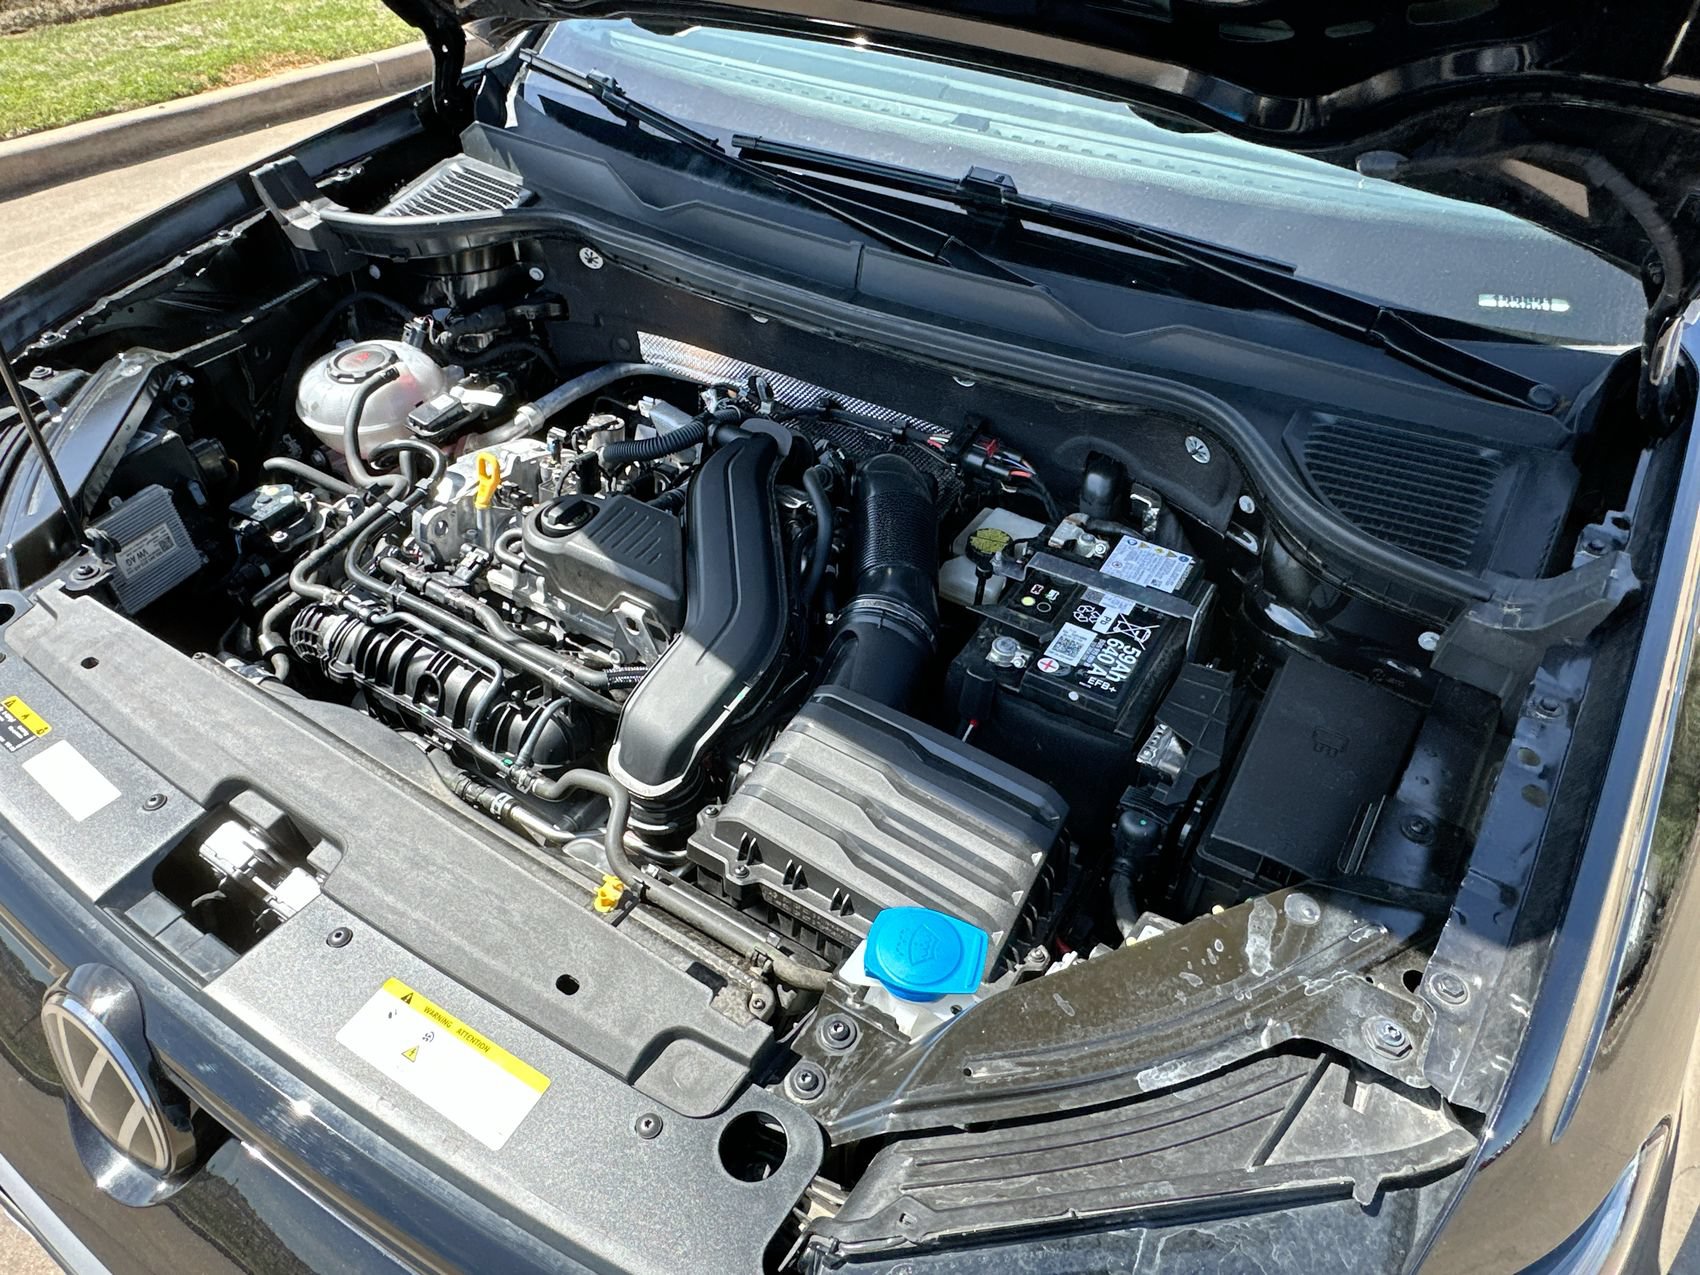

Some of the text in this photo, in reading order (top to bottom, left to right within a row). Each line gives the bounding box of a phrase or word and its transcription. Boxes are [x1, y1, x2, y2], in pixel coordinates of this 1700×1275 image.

[125, 555, 137, 567] AG
[137, 548, 149, 561] VW
[1100, 615, 1112, 626] Pb
[1097, 638, 1124, 665] 640
[1087, 662, 1108, 677] A
[1105, 645, 1142, 682] 59Ah
[1087, 676, 1117, 693] EFB+
[423, 1006, 491, 1053] WARNING ATTENTION
